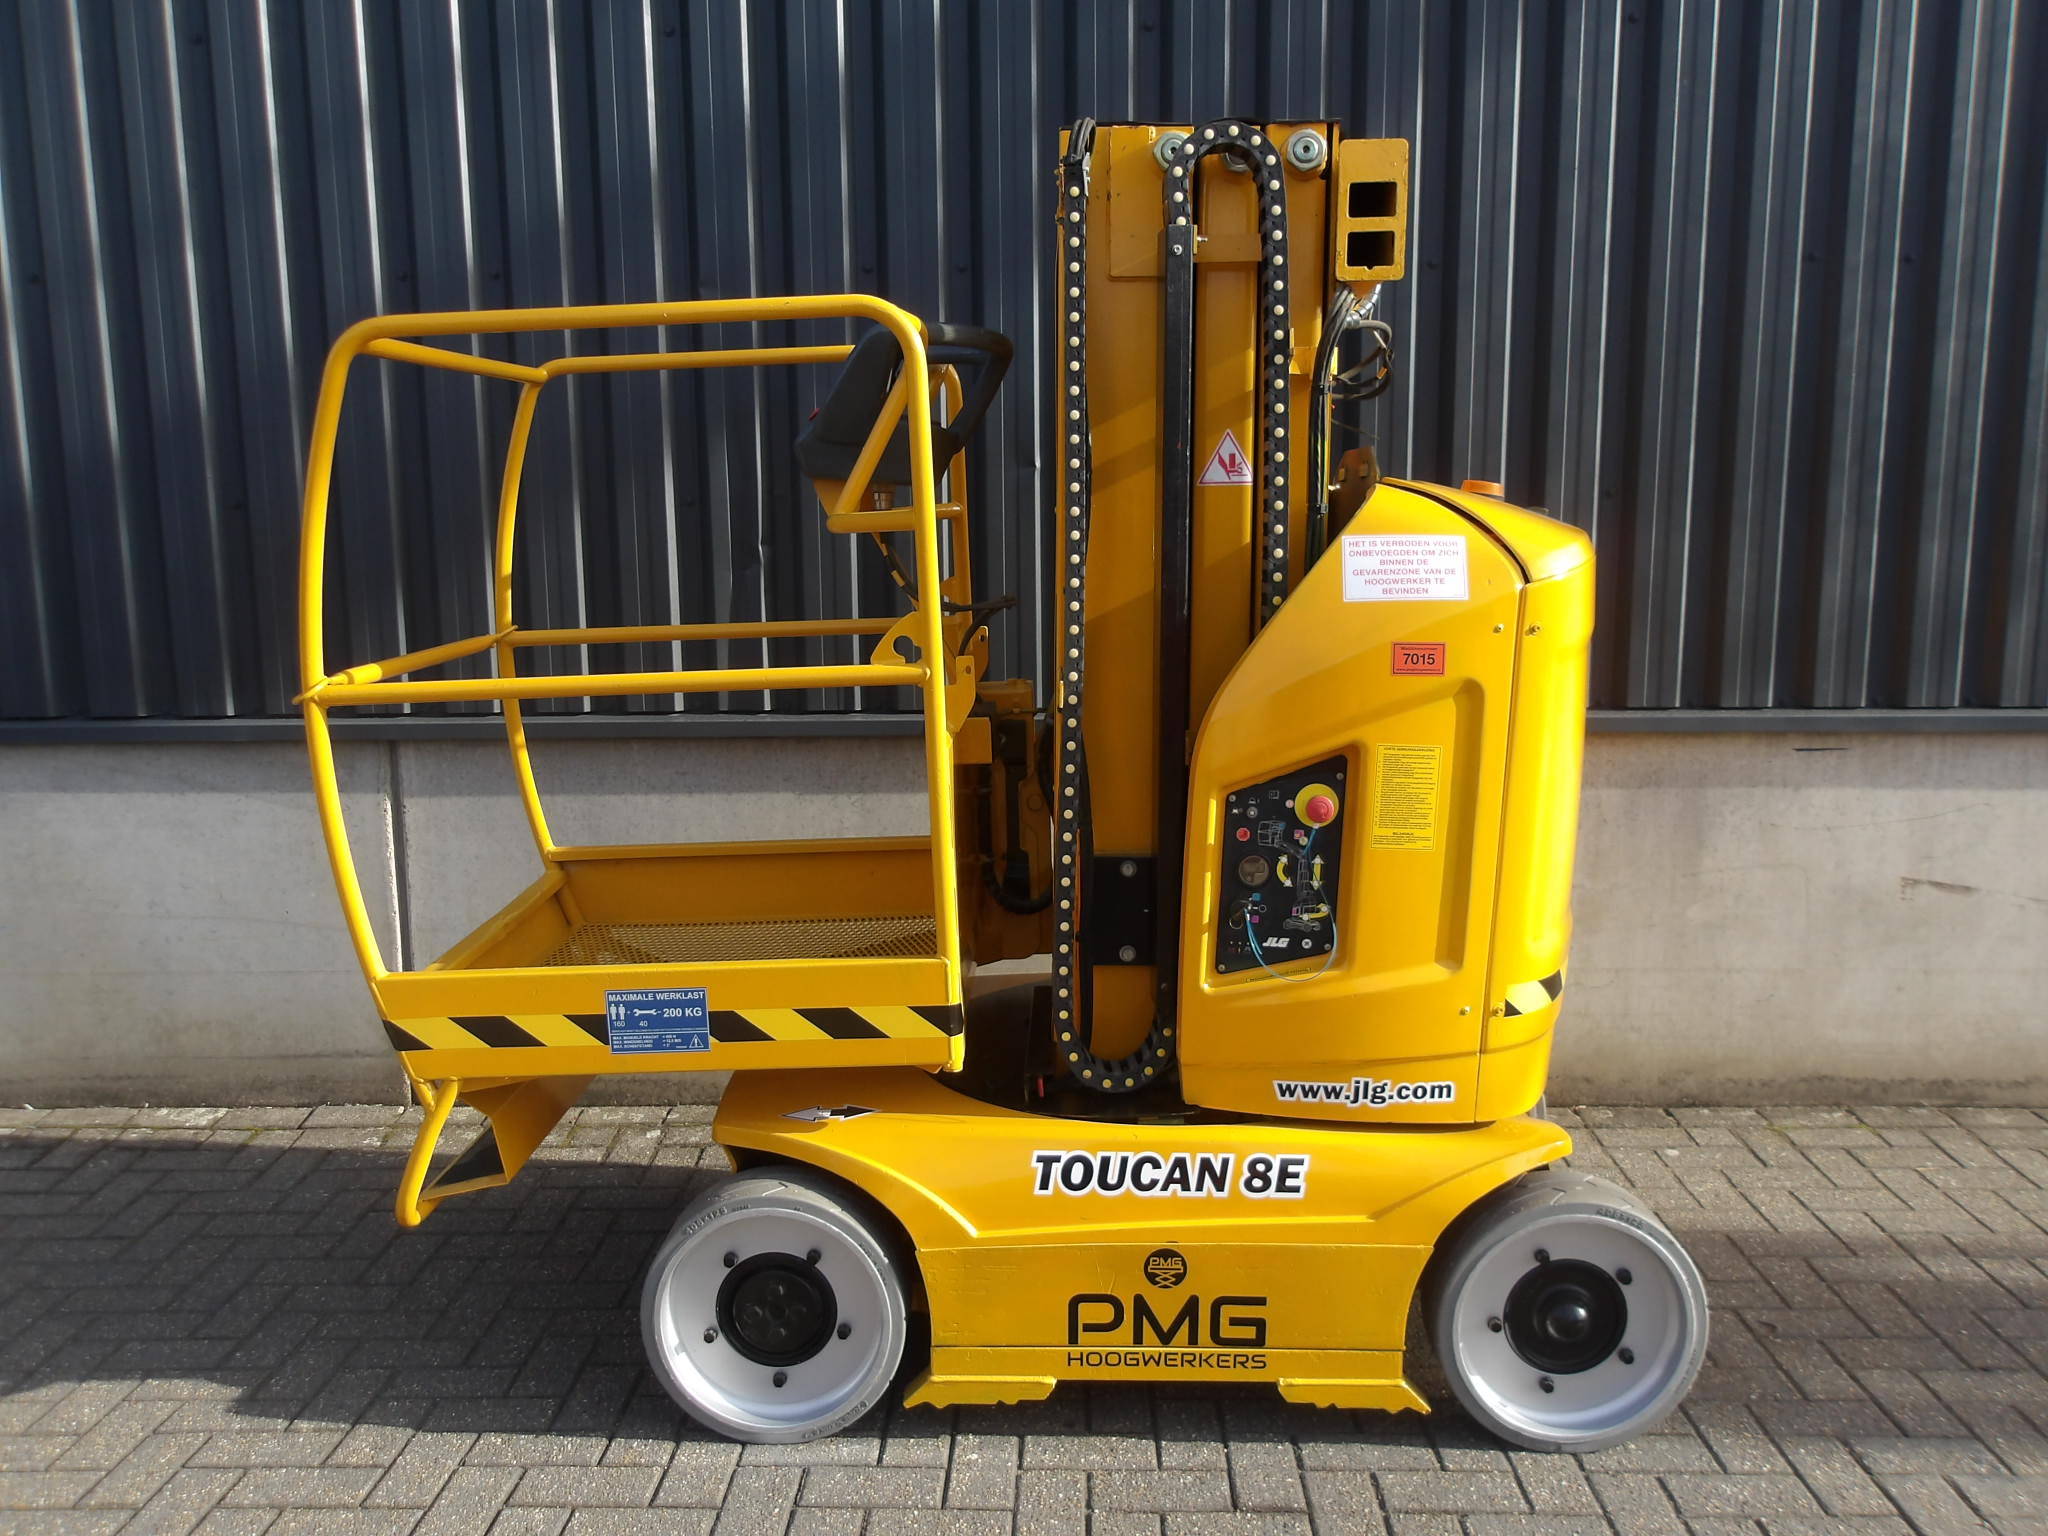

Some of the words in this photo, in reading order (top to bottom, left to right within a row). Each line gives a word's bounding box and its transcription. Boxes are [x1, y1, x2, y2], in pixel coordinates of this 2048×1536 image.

[1348, 540, 1366, 548] HET
[1348, 549, 1419, 557] ONBEVOEGDEN
[1352, 568, 1420, 576] GEVARENZONE
[1434, 577, 1445, 585] TE
[1382, 587, 1429, 595] BEVINDEN
[1403, 653, 1436, 665] 7015
[1262, 936, 1290, 948] JLG
[608, 993, 654, 1001] MAXIMALE
[656, 991, 705, 1000] WERKLAST
[663, 1008, 682, 1017] 200
[685, 1007, 702, 1017] KG
[1276, 1079, 1452, 1105] www.jlg.com
[1035, 1154, 1231, 1192] TOUCAN
[1243, 1155, 1305, 1193] 8E
[1149, 1256, 1183, 1267] PMG
[1068, 1293, 1268, 1347] PMG
[1067, 1351, 1267, 1369] HOOGWERKERS
